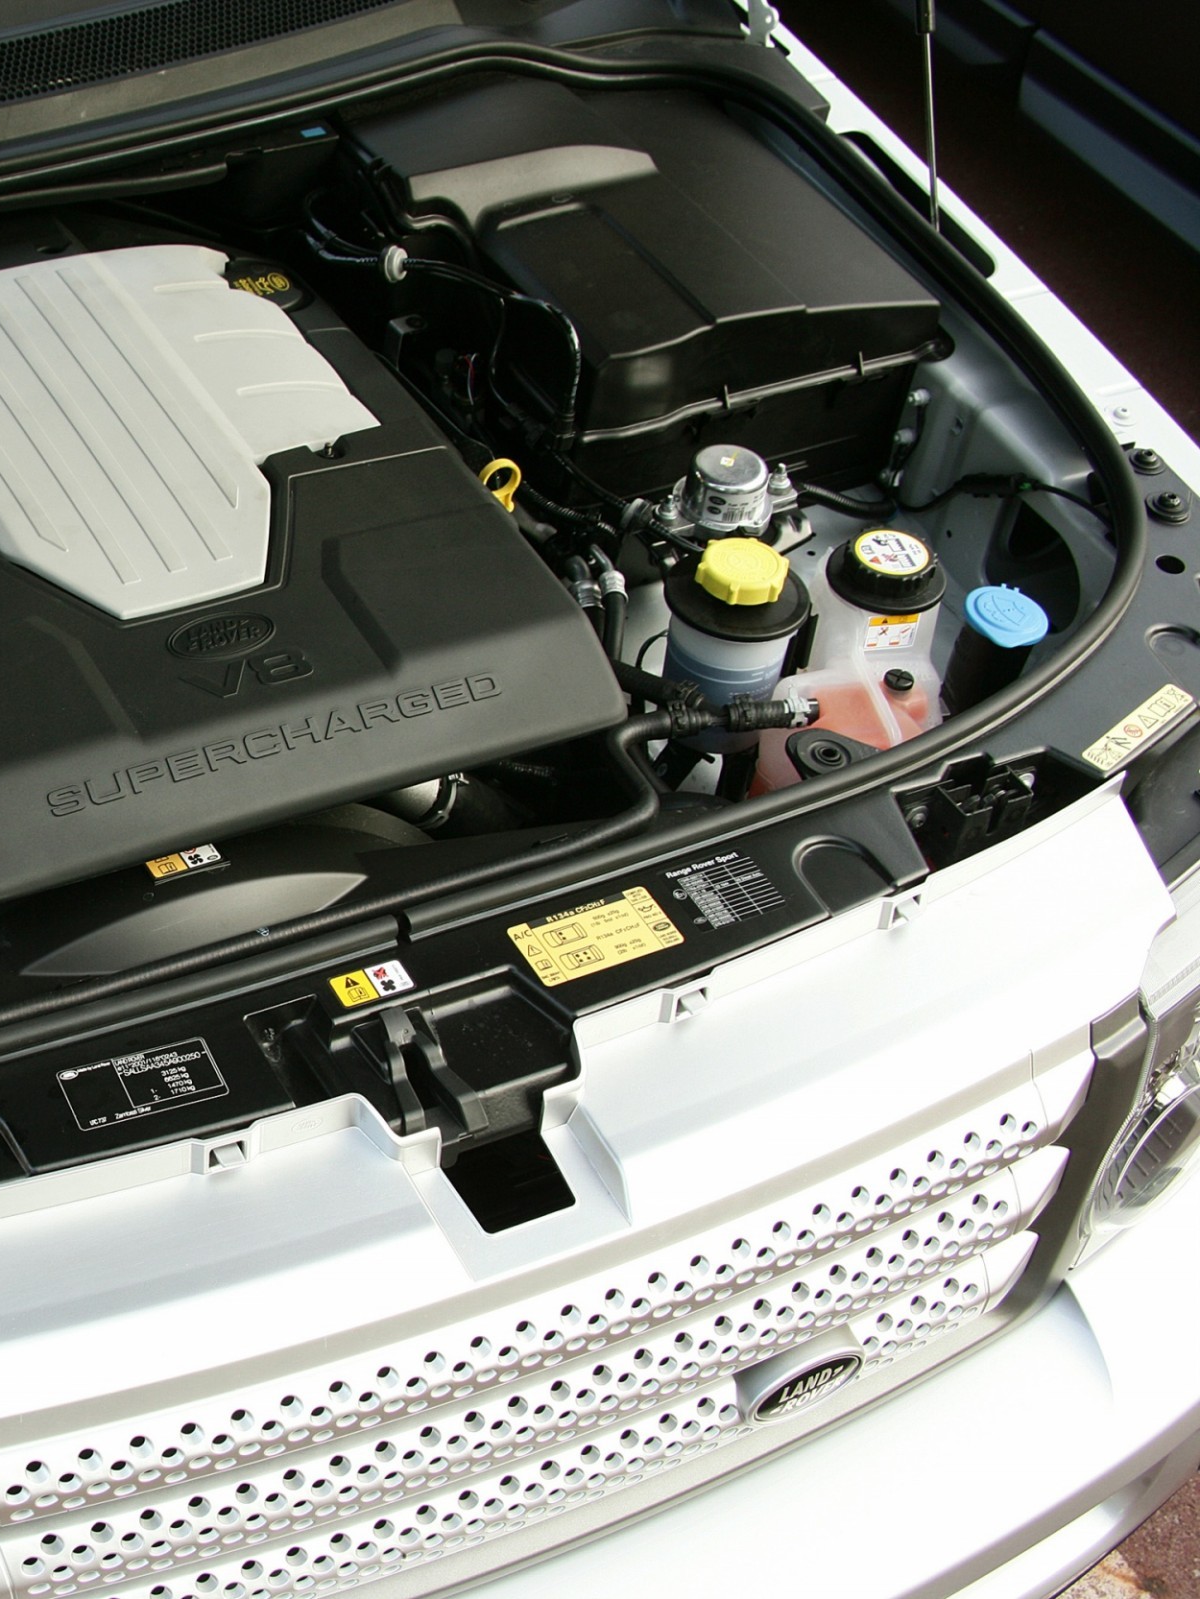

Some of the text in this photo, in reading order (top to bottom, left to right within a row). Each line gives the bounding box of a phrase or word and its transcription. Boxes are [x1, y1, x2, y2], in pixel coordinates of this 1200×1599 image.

[187, 619, 237, 641] LAND
[201, 627, 260, 651] ROVER
[178, 650, 314, 699] V8
[46, 671, 503, 817] SUPERCHARGED
[665, 852, 739, 879] Range Rover Sport
[513, 929, 532, 941] A/C
[779, 1367, 832, 1403] LAND
[780, 1374, 846, 1414] ROVER
